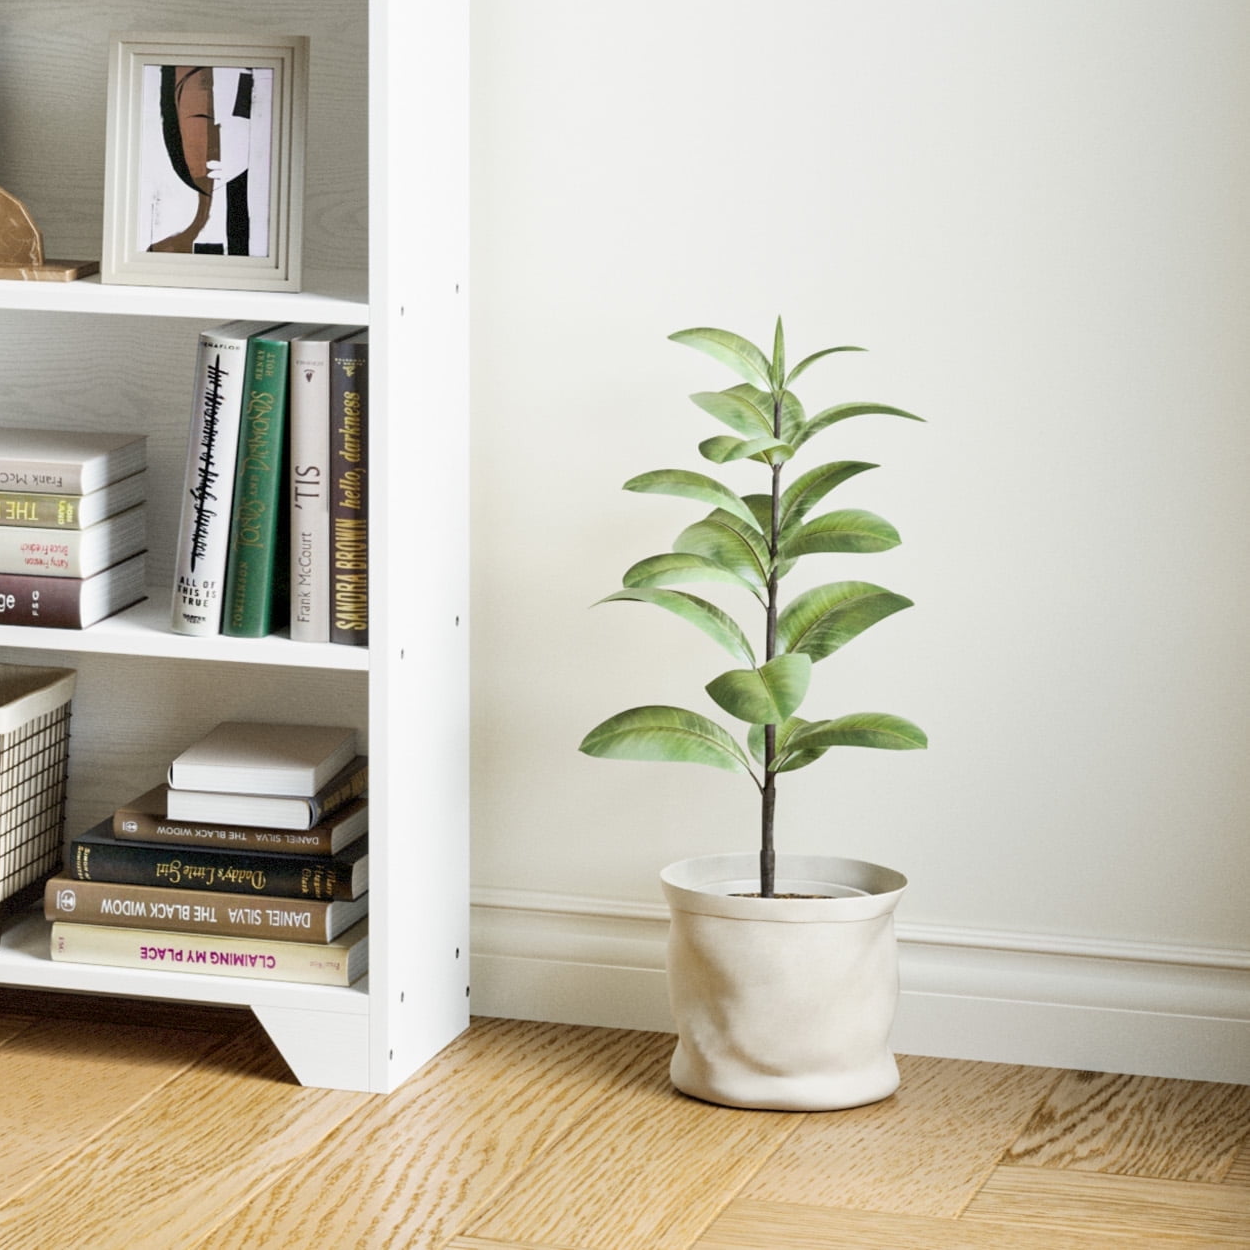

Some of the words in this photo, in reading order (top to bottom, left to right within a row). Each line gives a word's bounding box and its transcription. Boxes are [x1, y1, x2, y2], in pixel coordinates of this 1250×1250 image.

[265, 352, 276, 376] HOLT
[338, 391, 360, 462] darkness
[33, 474, 62, 487] Frank
[339, 467, 364, 510] hello,
[6, 502, 38, 520] THE
[336, 518, 366, 570] BROWN
[298, 532, 312, 585] McCourt
[178, 584, 200, 597] THIS
[206, 590, 217, 598] IS
[180, 576, 196, 587] ALL
[203, 580, 216, 588] OF
[182, 596, 208, 608] TRUE
[298, 590, 310, 623] Frank
[335, 575, 366, 631] SANDRA
[156, 826, 192, 837] WIDOW
[195, 830, 226, 839] BLACK
[228, 832, 247, 840] THE
[256, 834, 281, 843] SILVA
[286, 836, 319, 846] DANIEL
[156, 860, 182, 884] Girl
[183, 864, 215, 886] Little
[217, 867, 266, 890] Daddy's
[101, 898, 146, 918] WIDOW
[150, 902, 190, 920] BLACK
[194, 905, 217, 922] THE
[228, 908, 262, 926] SILVA
[266, 910, 311, 928] DANIEL
[140, 947, 183, 960] PLACE
[188, 949, 206, 962] MY
[211, 952, 276, 969] CLAIMING
